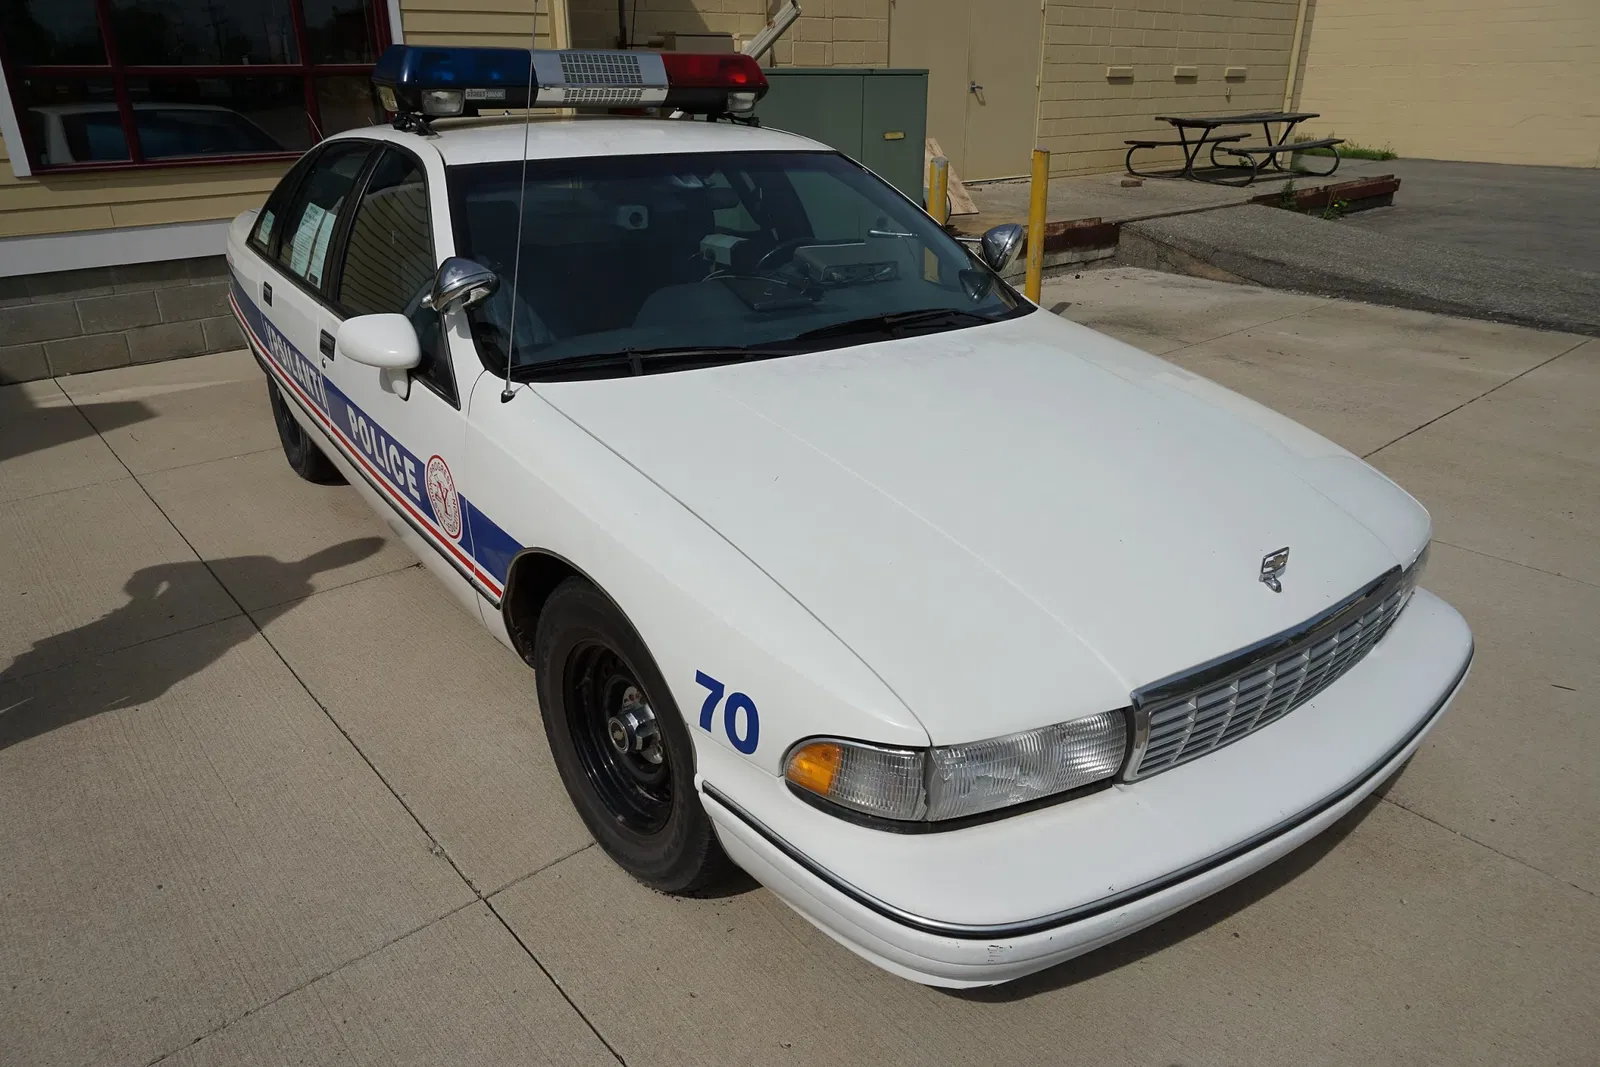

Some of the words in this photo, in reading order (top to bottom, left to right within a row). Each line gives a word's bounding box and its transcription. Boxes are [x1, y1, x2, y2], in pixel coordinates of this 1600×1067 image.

[264, 321, 327, 408] YPSILANTI
[346, 404, 421, 502] POLICE
[695, 669, 760, 755] 70
